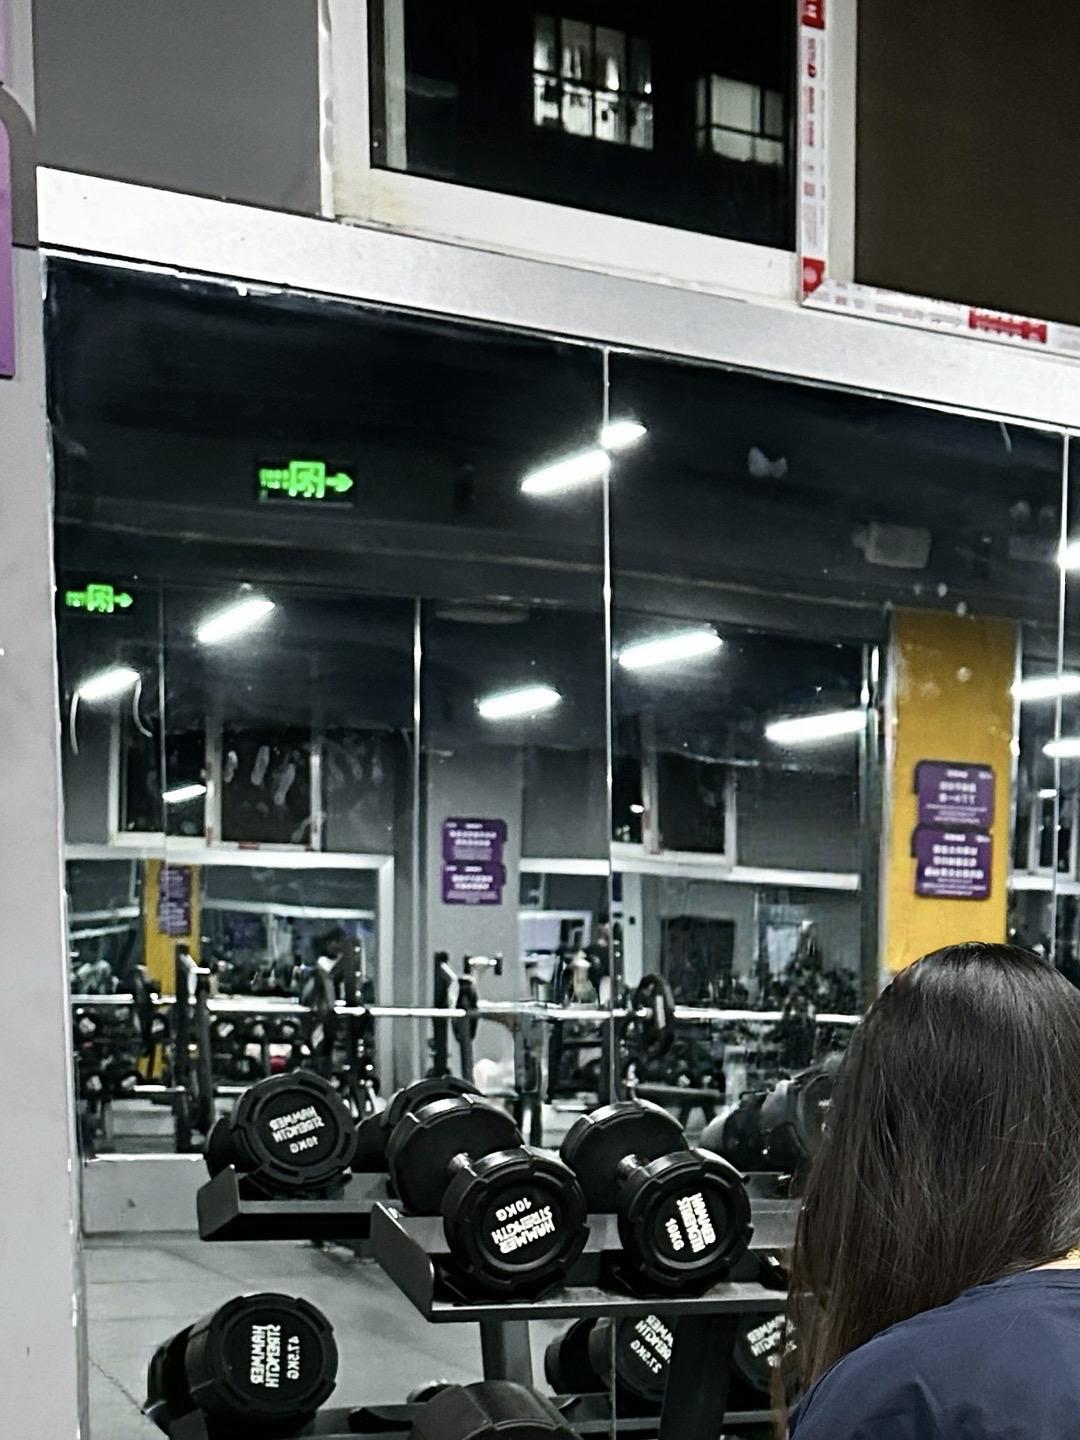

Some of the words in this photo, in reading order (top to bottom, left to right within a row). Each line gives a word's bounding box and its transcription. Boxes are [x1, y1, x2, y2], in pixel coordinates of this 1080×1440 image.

[491, 1205, 553, 1244] STRENGTH
[495, 1197, 532, 1221] 10KG
[676, 1196, 706, 1253] STRENGTH
[687, 1192, 716, 1245] HAMMER
[499, 1220, 555, 1253] HAMMER
[665, 1217, 685, 1251] 10KG
